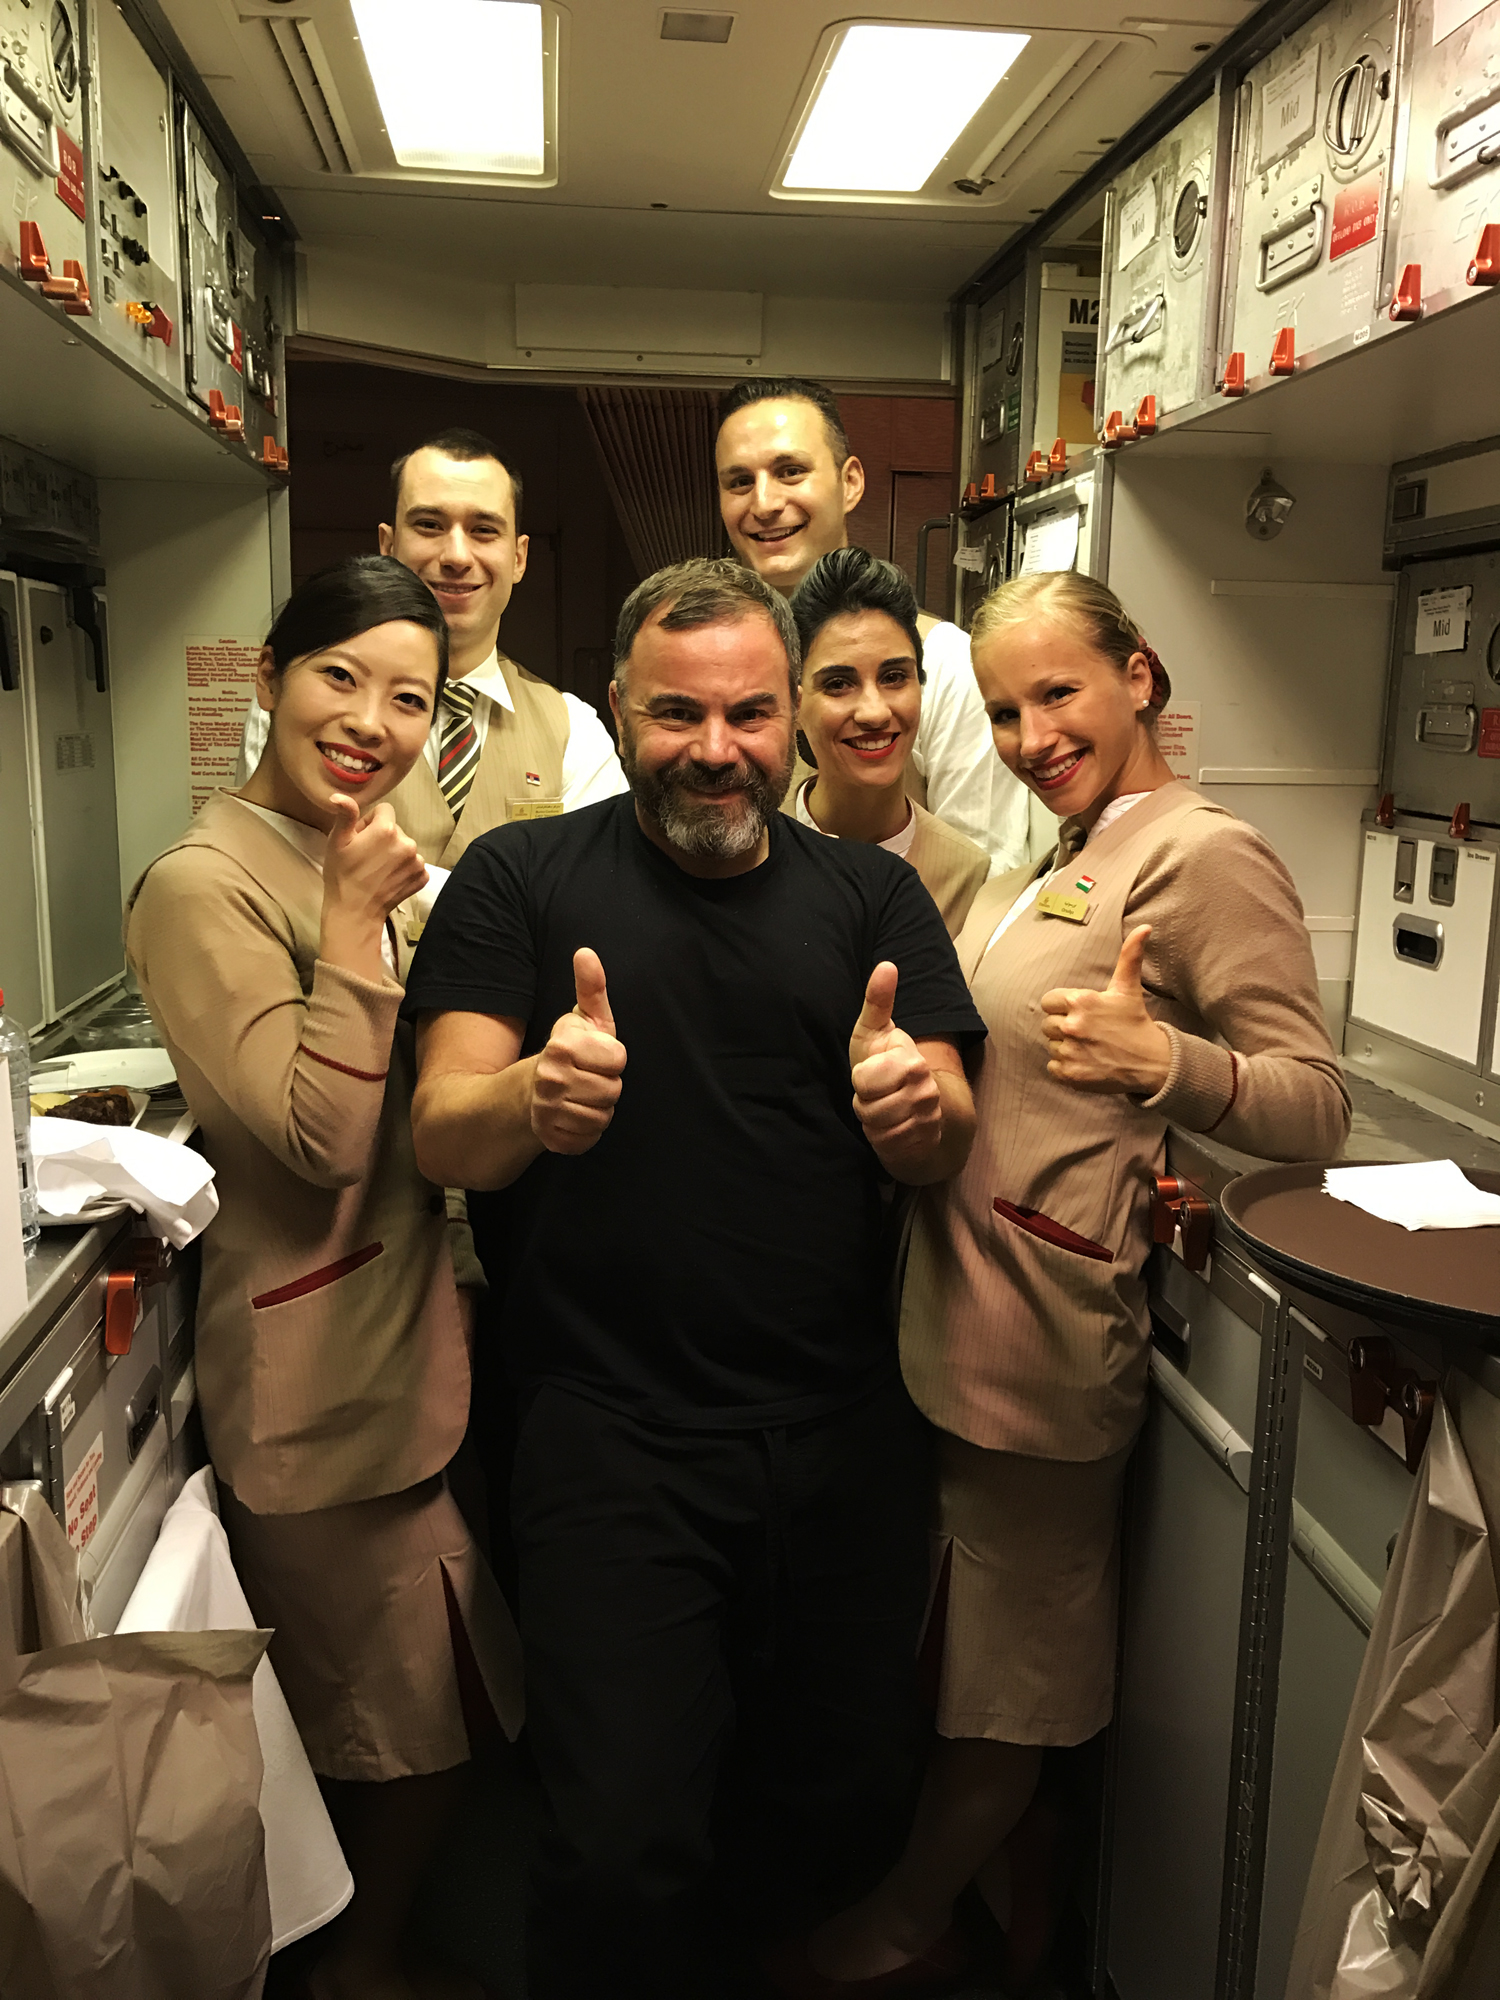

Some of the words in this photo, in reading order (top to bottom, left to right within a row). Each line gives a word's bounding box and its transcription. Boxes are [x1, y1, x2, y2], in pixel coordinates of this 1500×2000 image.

[1281, 94, 1300, 129] Mid
[1132, 213, 1145, 241] Mid
[1433, 618, 1450, 637] Mid
[68, 1517, 78, 1541] No
[80, 1484, 96, 1519] Seat
